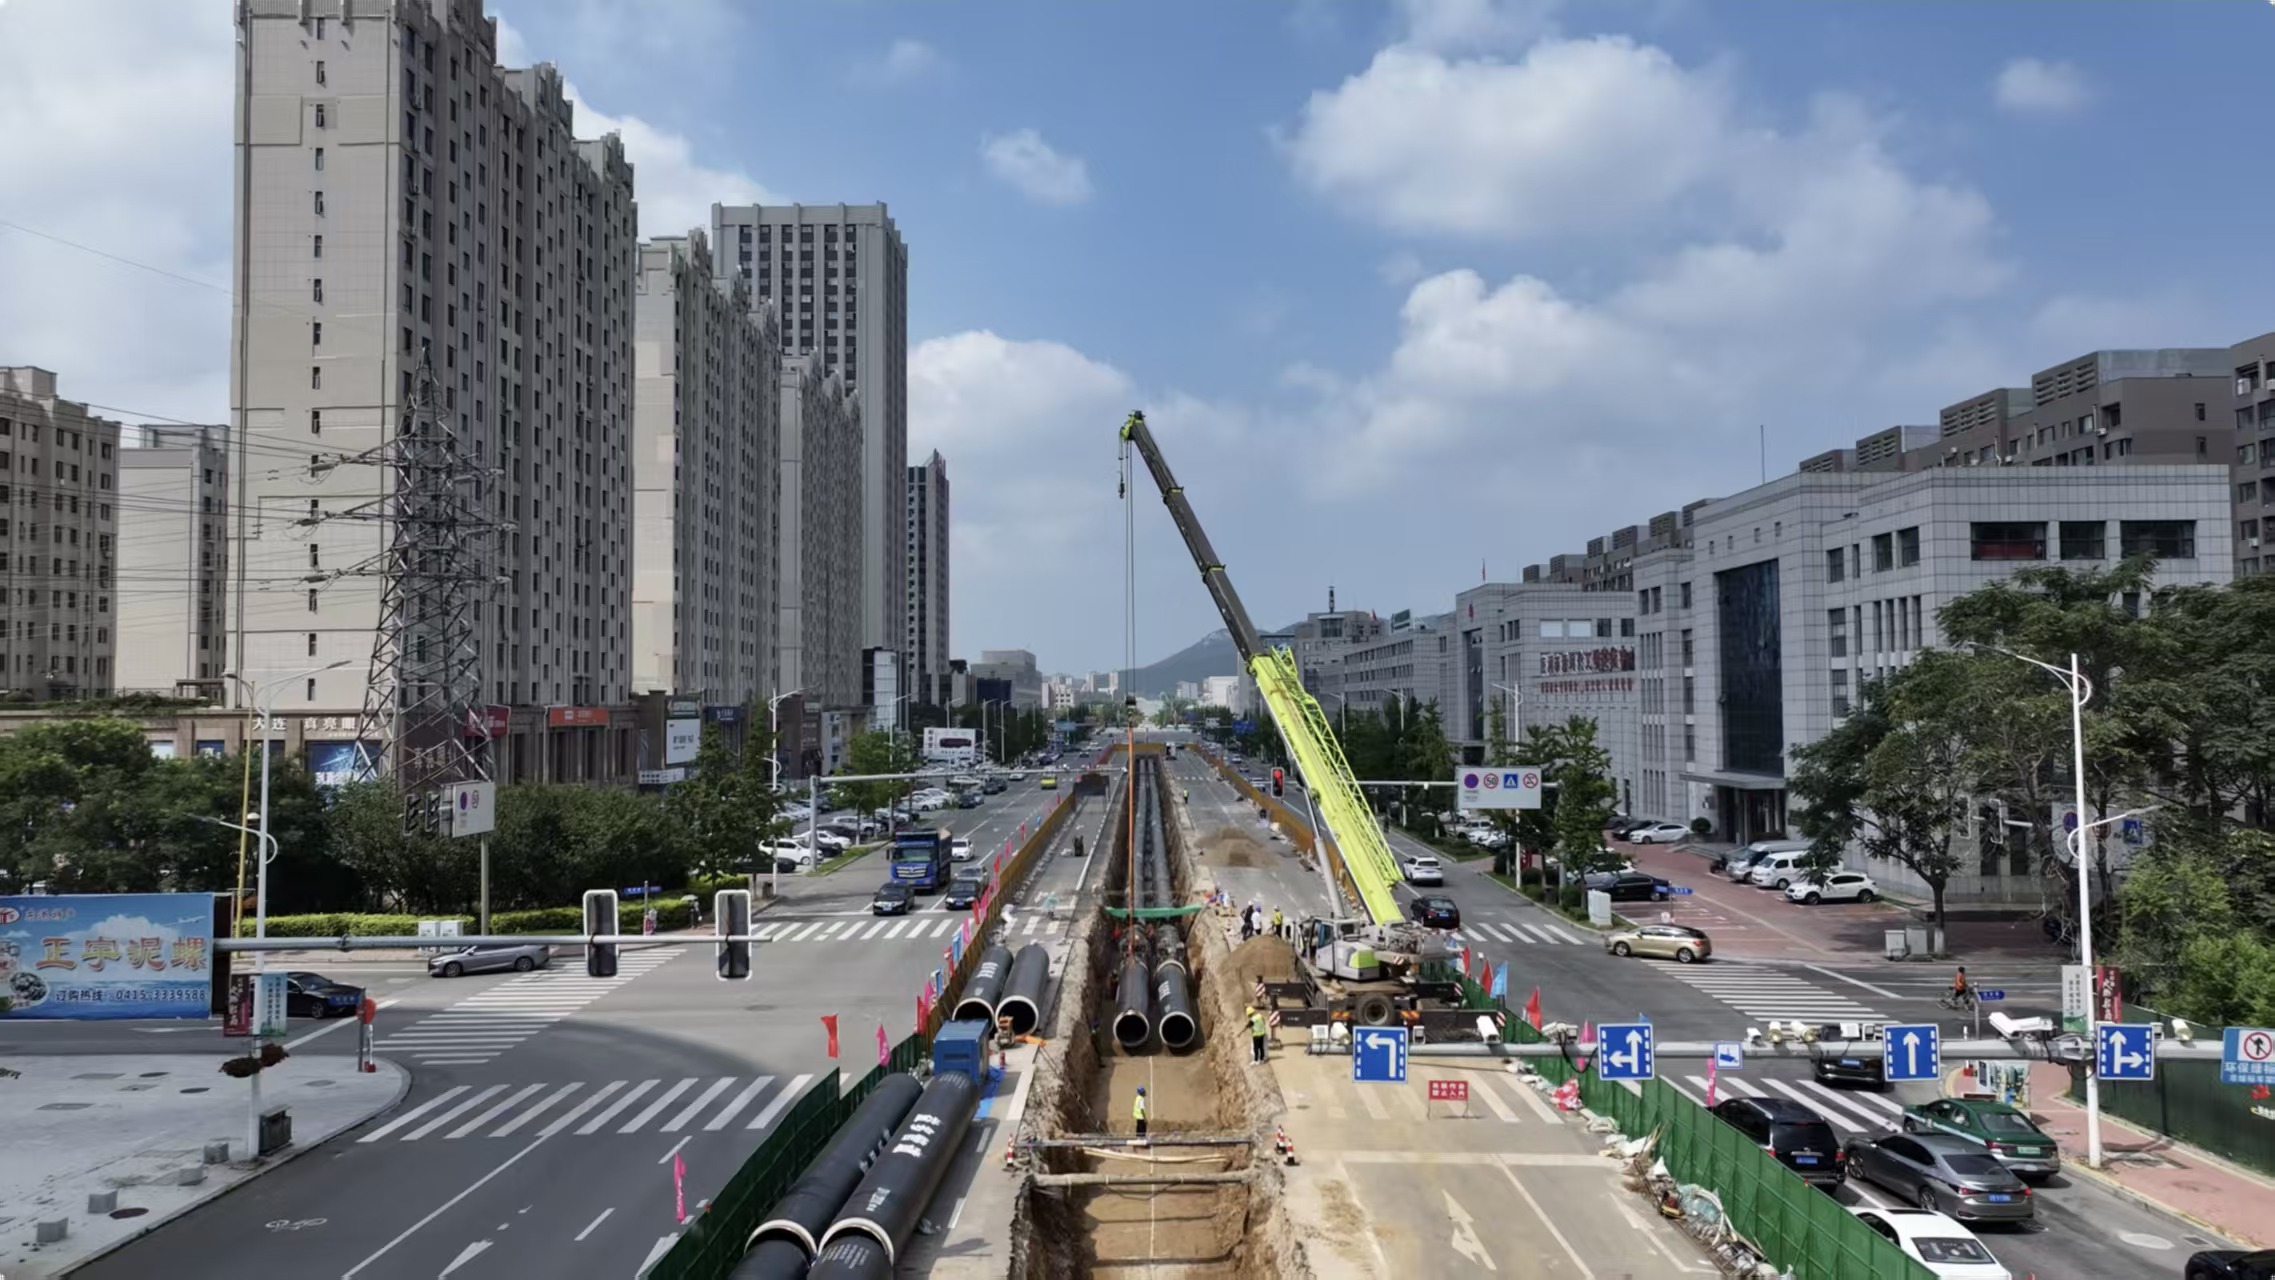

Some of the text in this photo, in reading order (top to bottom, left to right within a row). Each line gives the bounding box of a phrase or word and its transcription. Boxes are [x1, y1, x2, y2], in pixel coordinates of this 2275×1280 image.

[253, 717, 287, 730] 大连
[36, 936, 207, 971] 正宇泥螺
